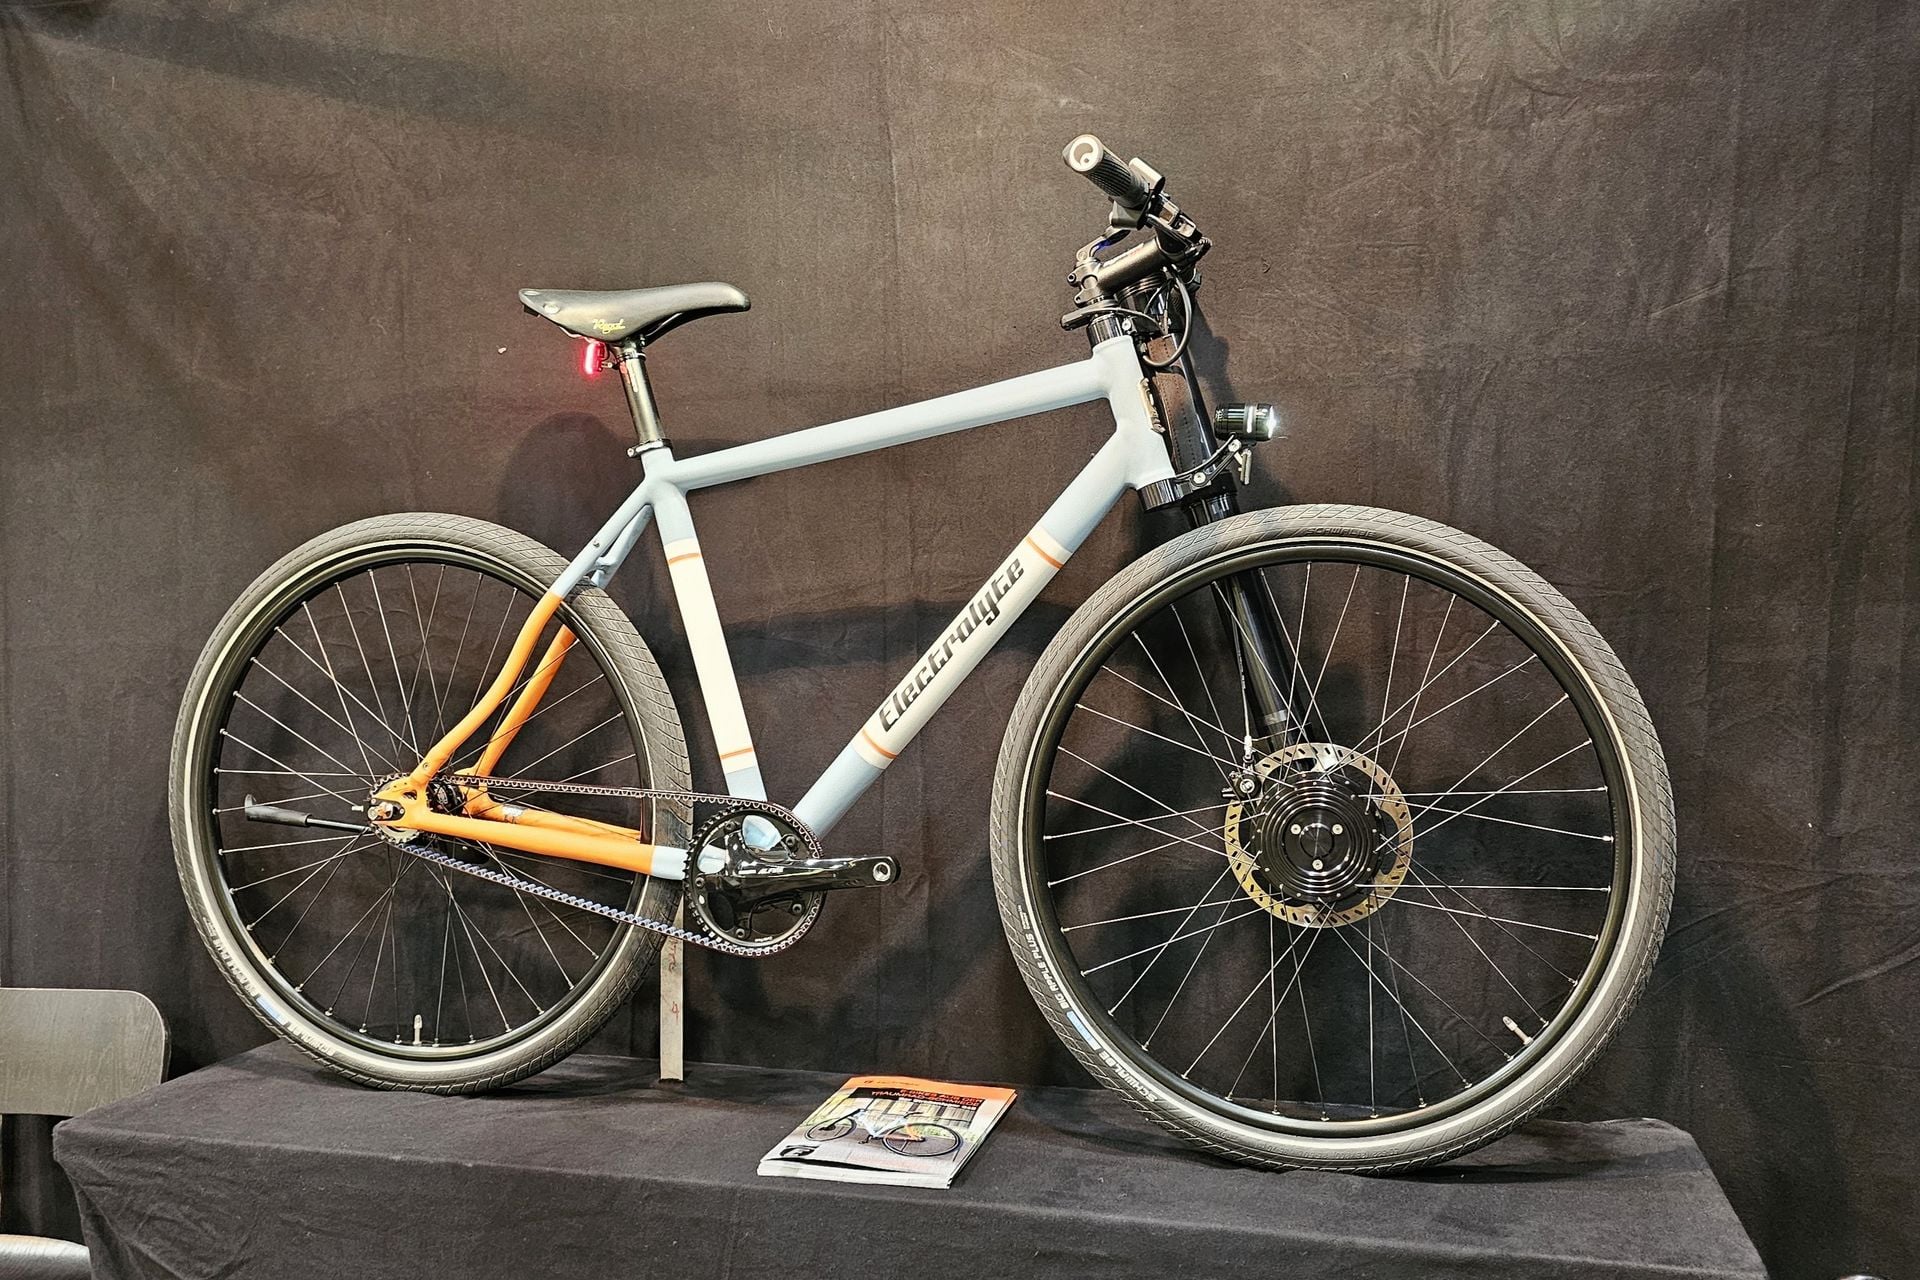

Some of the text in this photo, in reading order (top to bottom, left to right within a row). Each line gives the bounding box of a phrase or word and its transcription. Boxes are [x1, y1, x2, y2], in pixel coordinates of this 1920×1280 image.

[878, 558, 1025, 732] Electrolyte
[1025, 933, 1070, 1009] BIG APPLE PLUS
[1098, 1050, 1158, 1102] SCHWALBE
